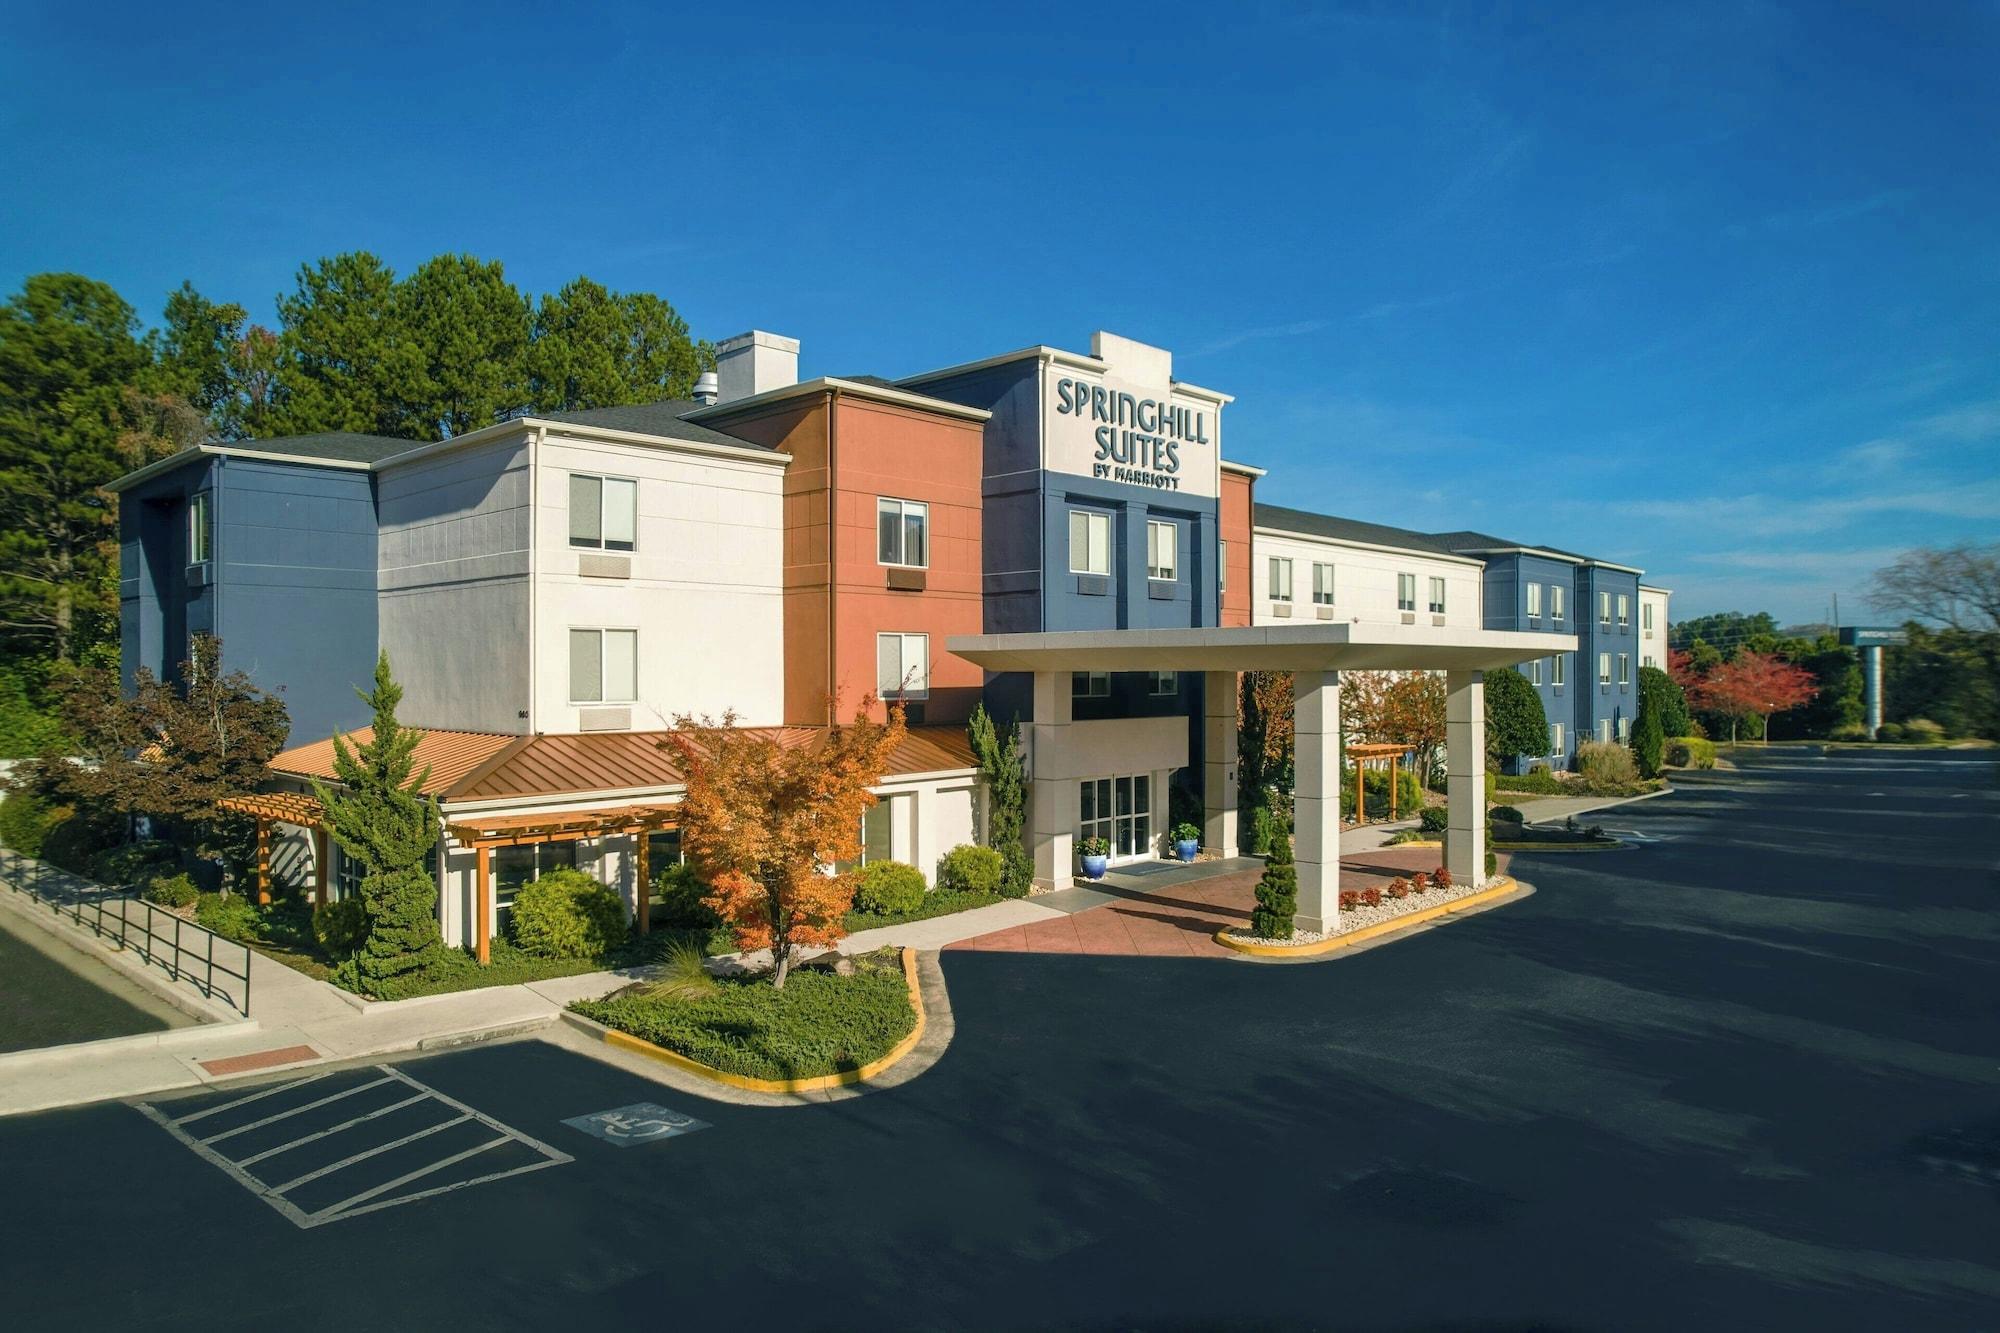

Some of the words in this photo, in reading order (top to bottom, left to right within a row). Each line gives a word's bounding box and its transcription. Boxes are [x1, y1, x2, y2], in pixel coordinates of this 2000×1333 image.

[1057, 378, 1209, 444] SPRINGHILL
[1095, 426, 1180, 473] SUITES
[1093, 463, 1111, 479] BY
[1114, 467, 1180, 490] MARRIOTT
